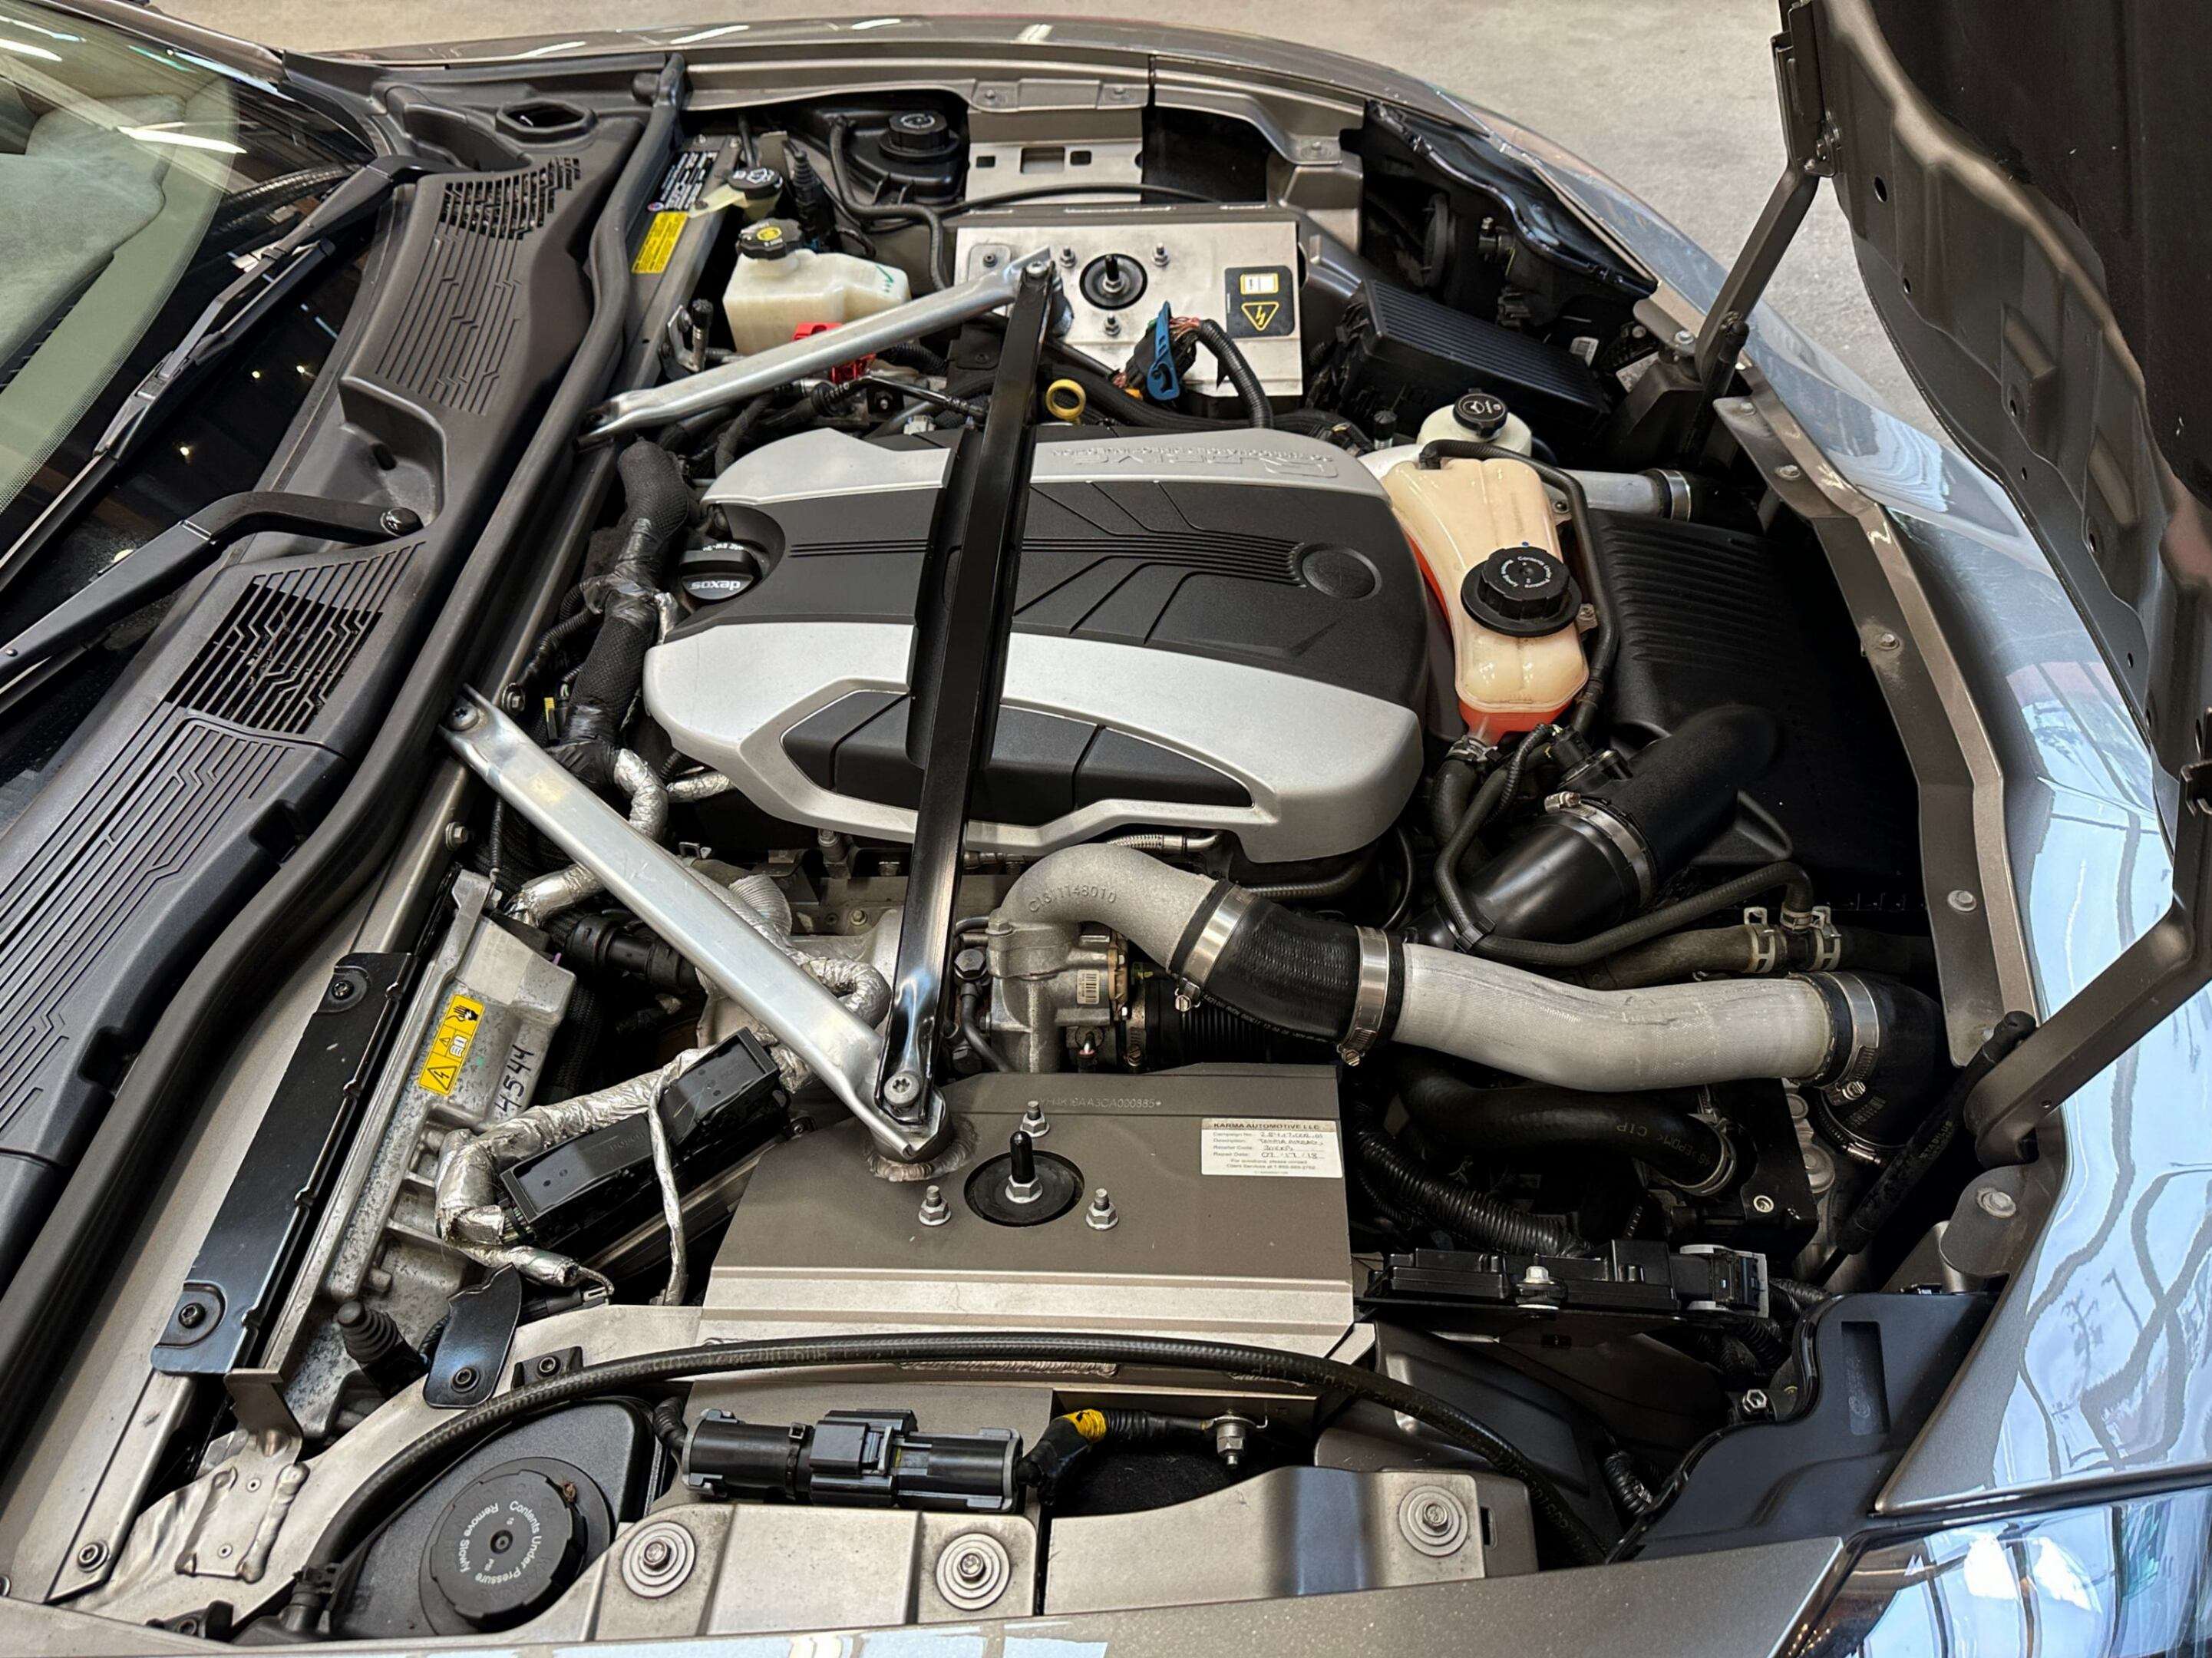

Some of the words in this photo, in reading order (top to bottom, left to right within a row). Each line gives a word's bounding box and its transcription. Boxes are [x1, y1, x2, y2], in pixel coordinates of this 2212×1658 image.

[690, 580, 741, 590] dexos
[494, 1044, 534, 1112] 4544
[464, 1502, 499, 1537] Remove
[510, 1501, 540, 1534] Contents
[458, 1538, 470, 1573] Slowly
[520, 1535, 542, 1569] Under
[475, 1567, 522, 1584] Pressure
